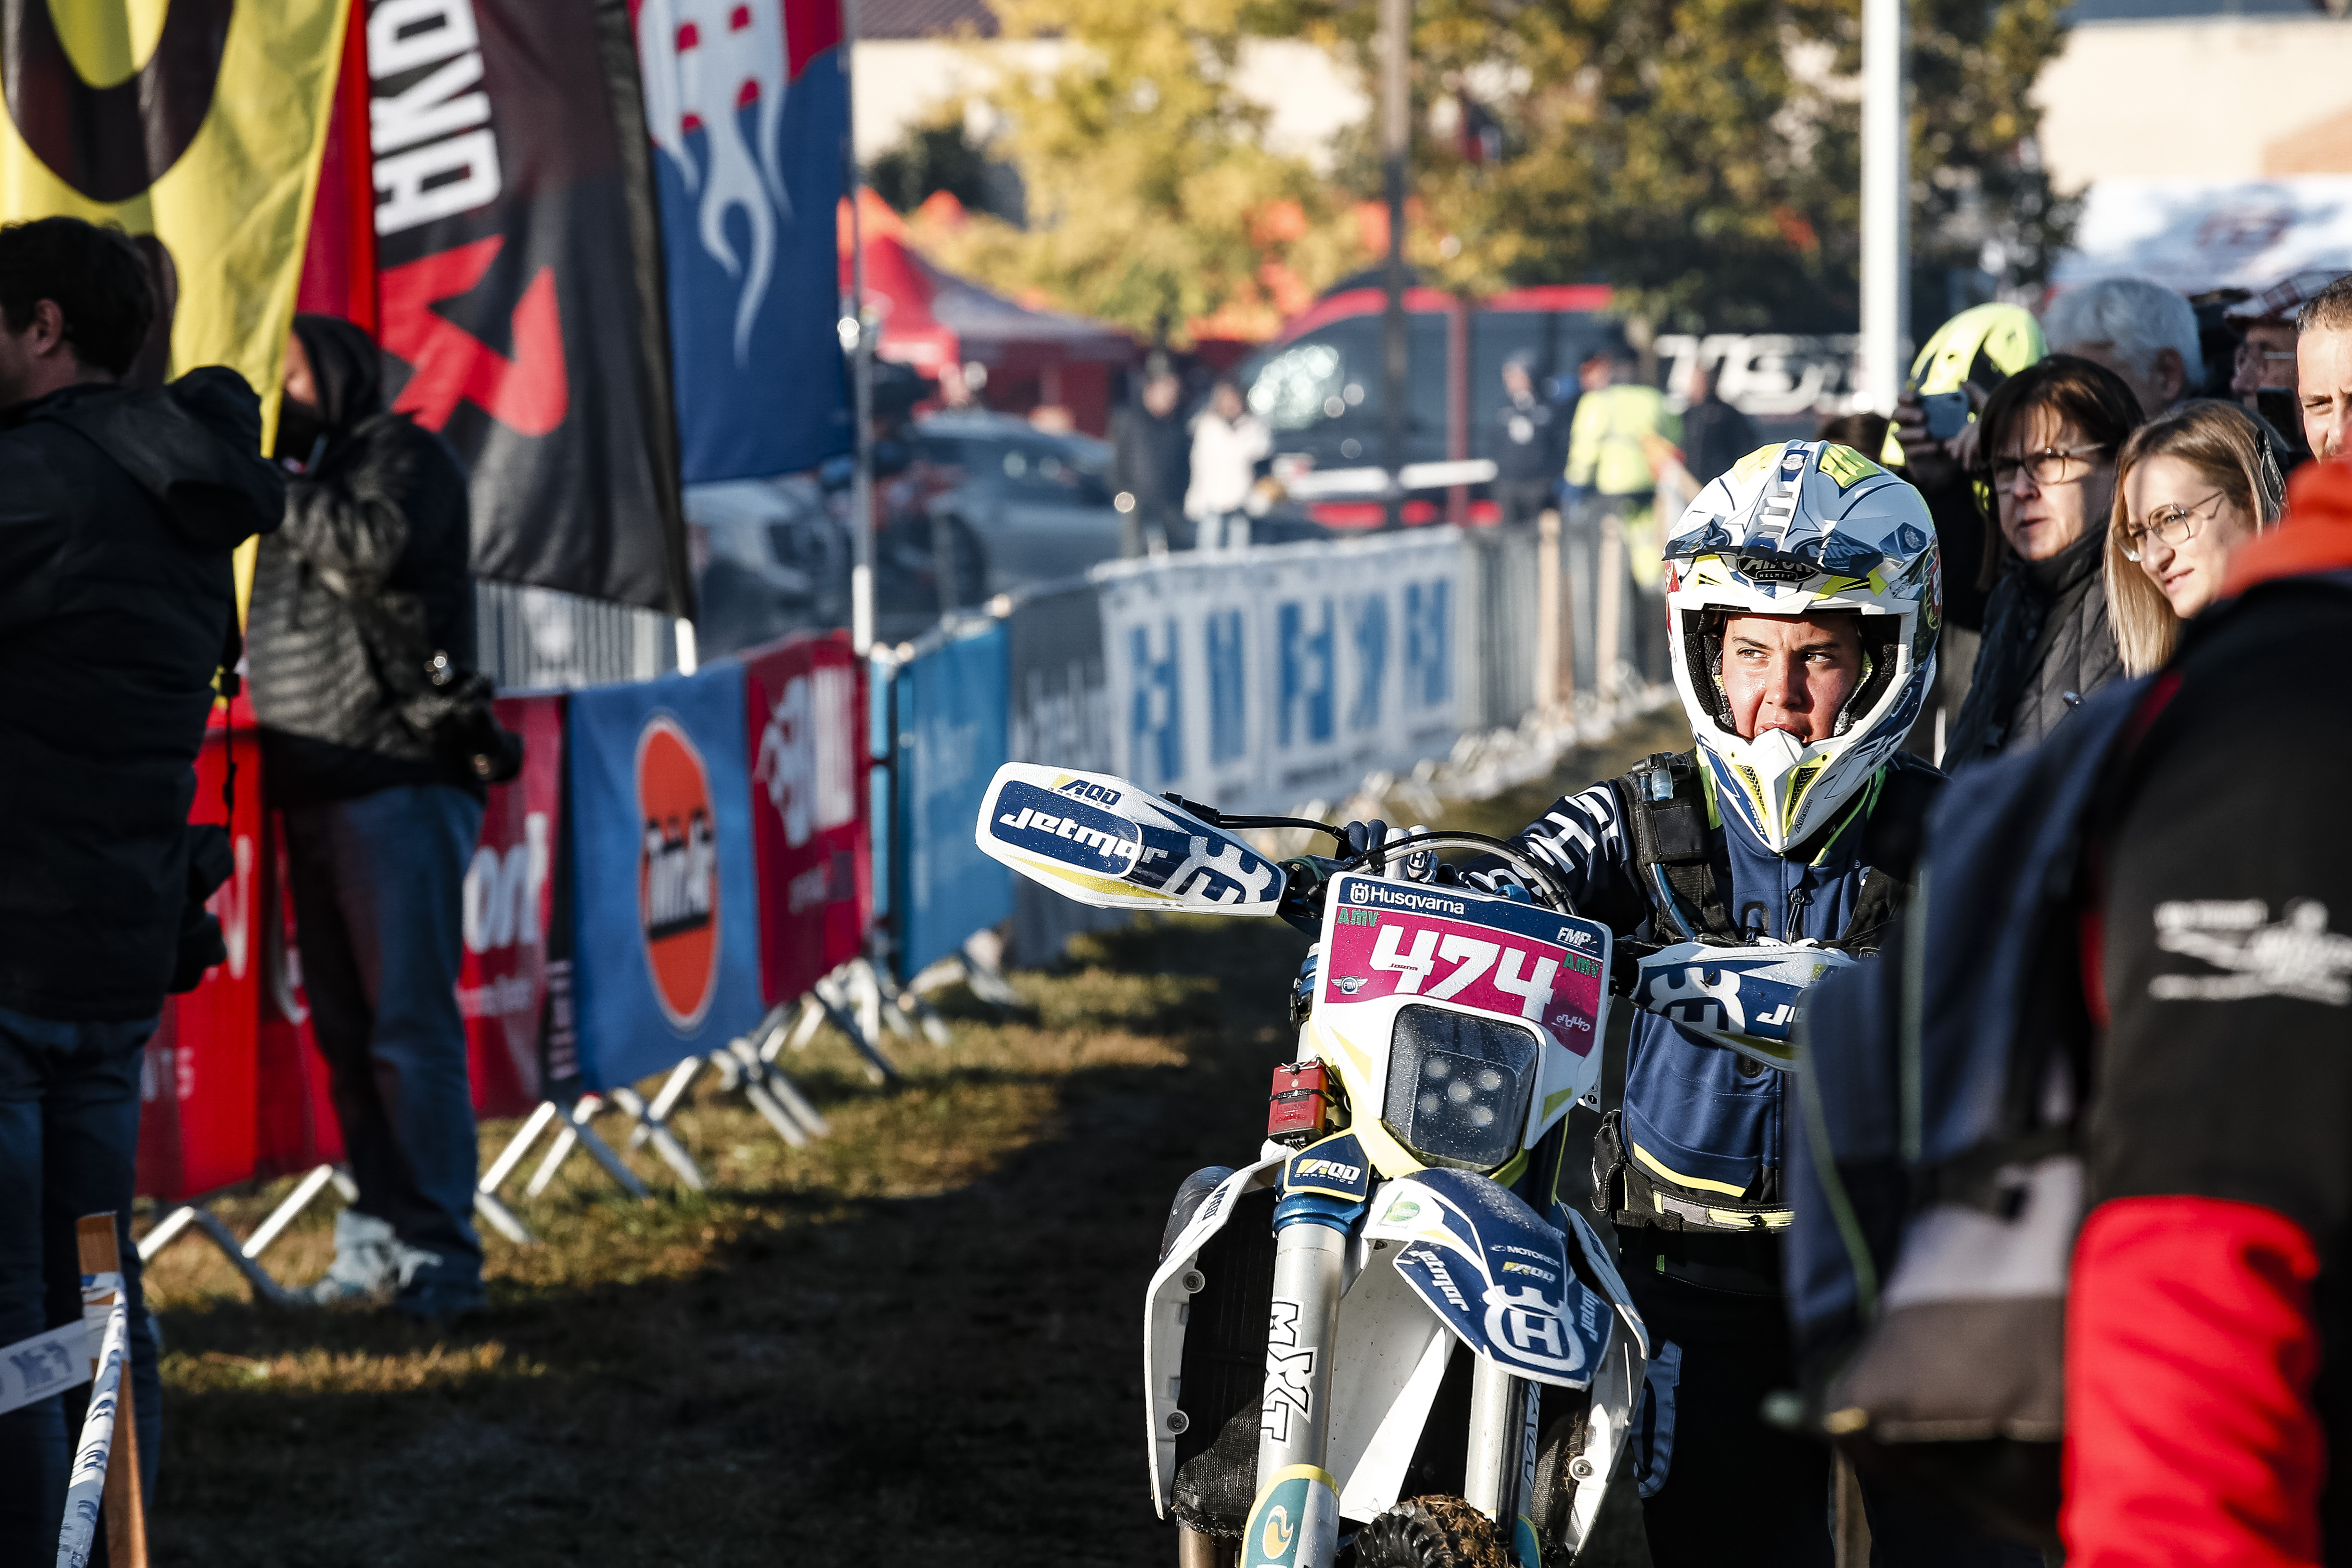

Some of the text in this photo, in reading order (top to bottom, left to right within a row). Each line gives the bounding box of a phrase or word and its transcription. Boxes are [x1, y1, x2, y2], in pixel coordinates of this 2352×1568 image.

[1058, 779, 1121, 806] AQD
[1370, 886, 1465, 915] Husqvarna
[1368, 923, 1560, 1023] 474
[1303, 1159, 1362, 1182] AQD
[1506, 1245, 1562, 1269] MOTOREX
